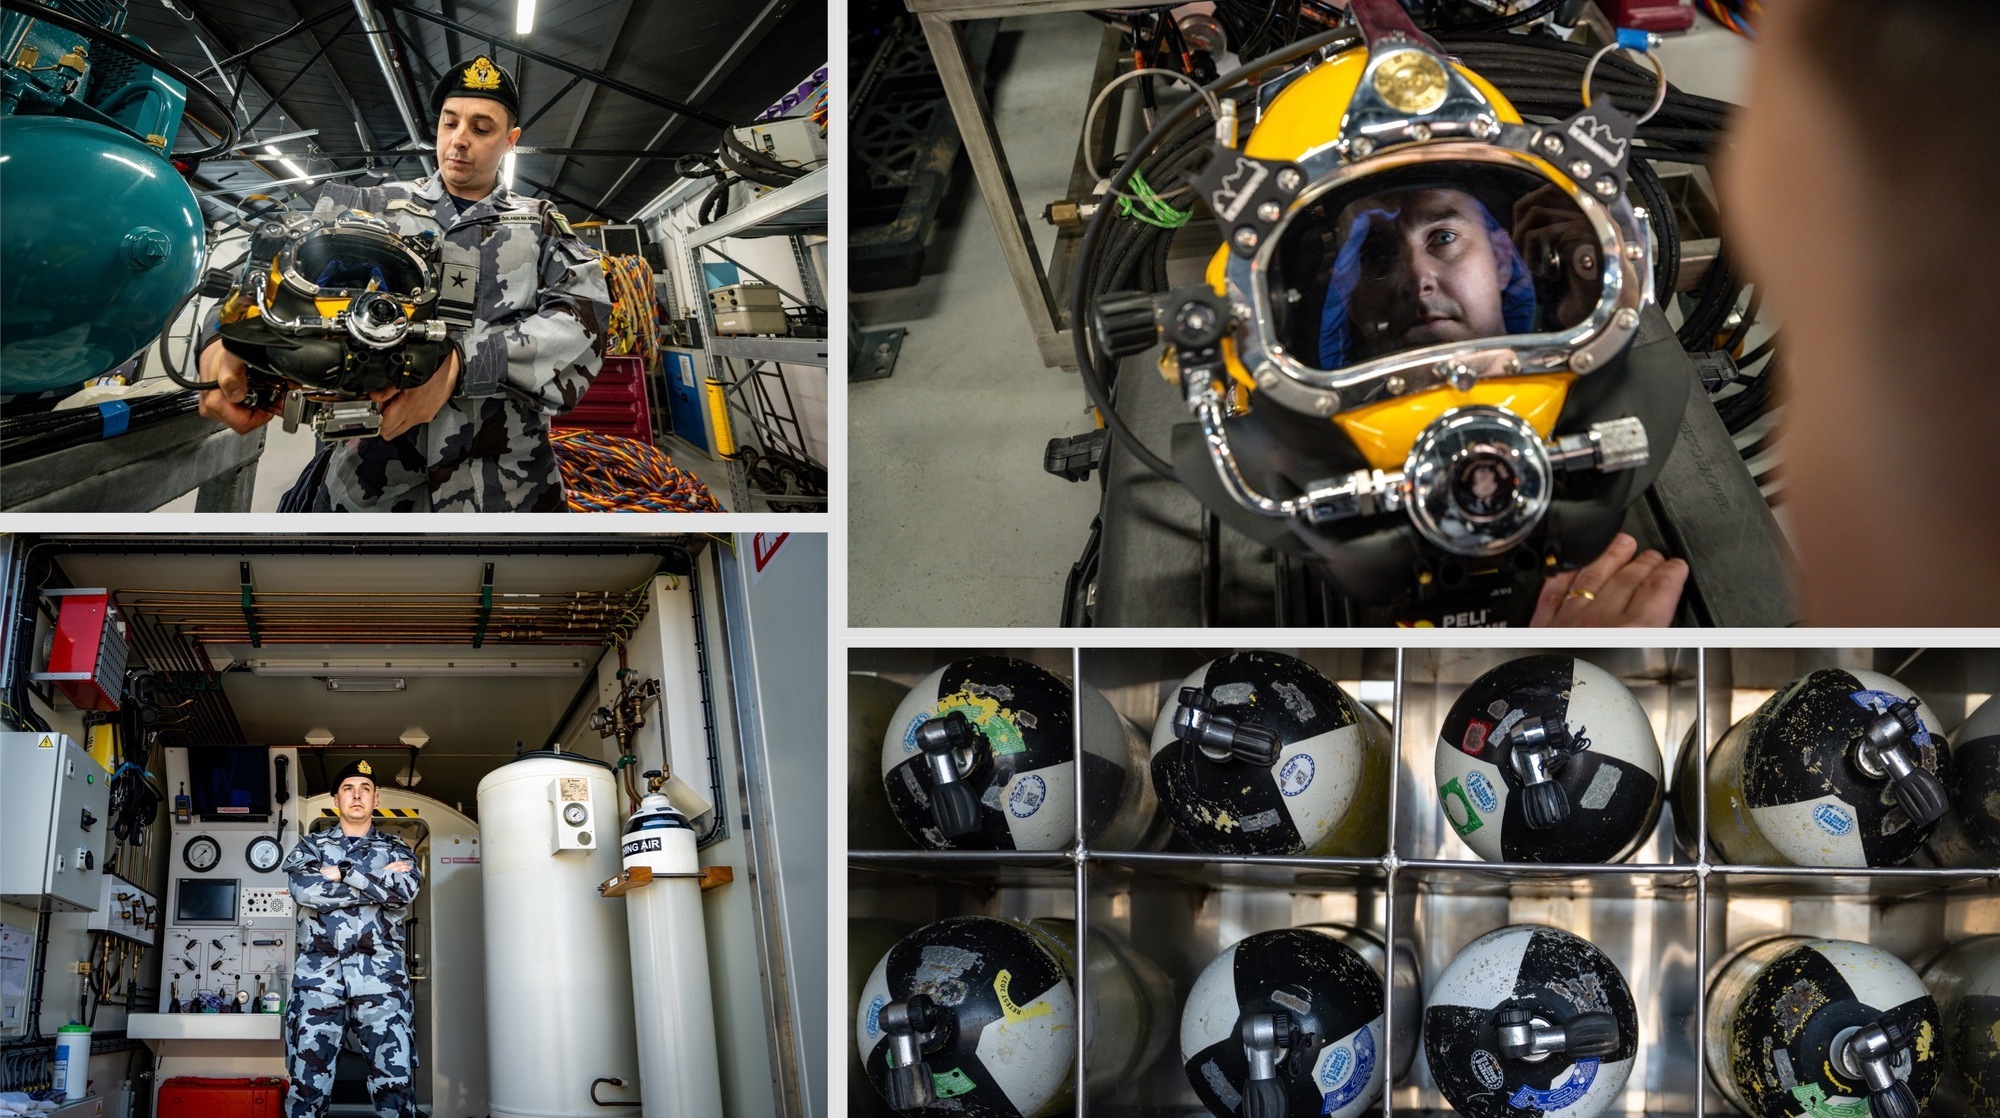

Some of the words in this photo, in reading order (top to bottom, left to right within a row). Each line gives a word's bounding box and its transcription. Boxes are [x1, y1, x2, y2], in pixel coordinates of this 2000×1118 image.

[1283, 761, 1296, 779] Faber
[641, 840, 660, 850] AIR
[1000, 975, 1008, 992] 2027
[1002, 995, 1021, 1015] RETEST
